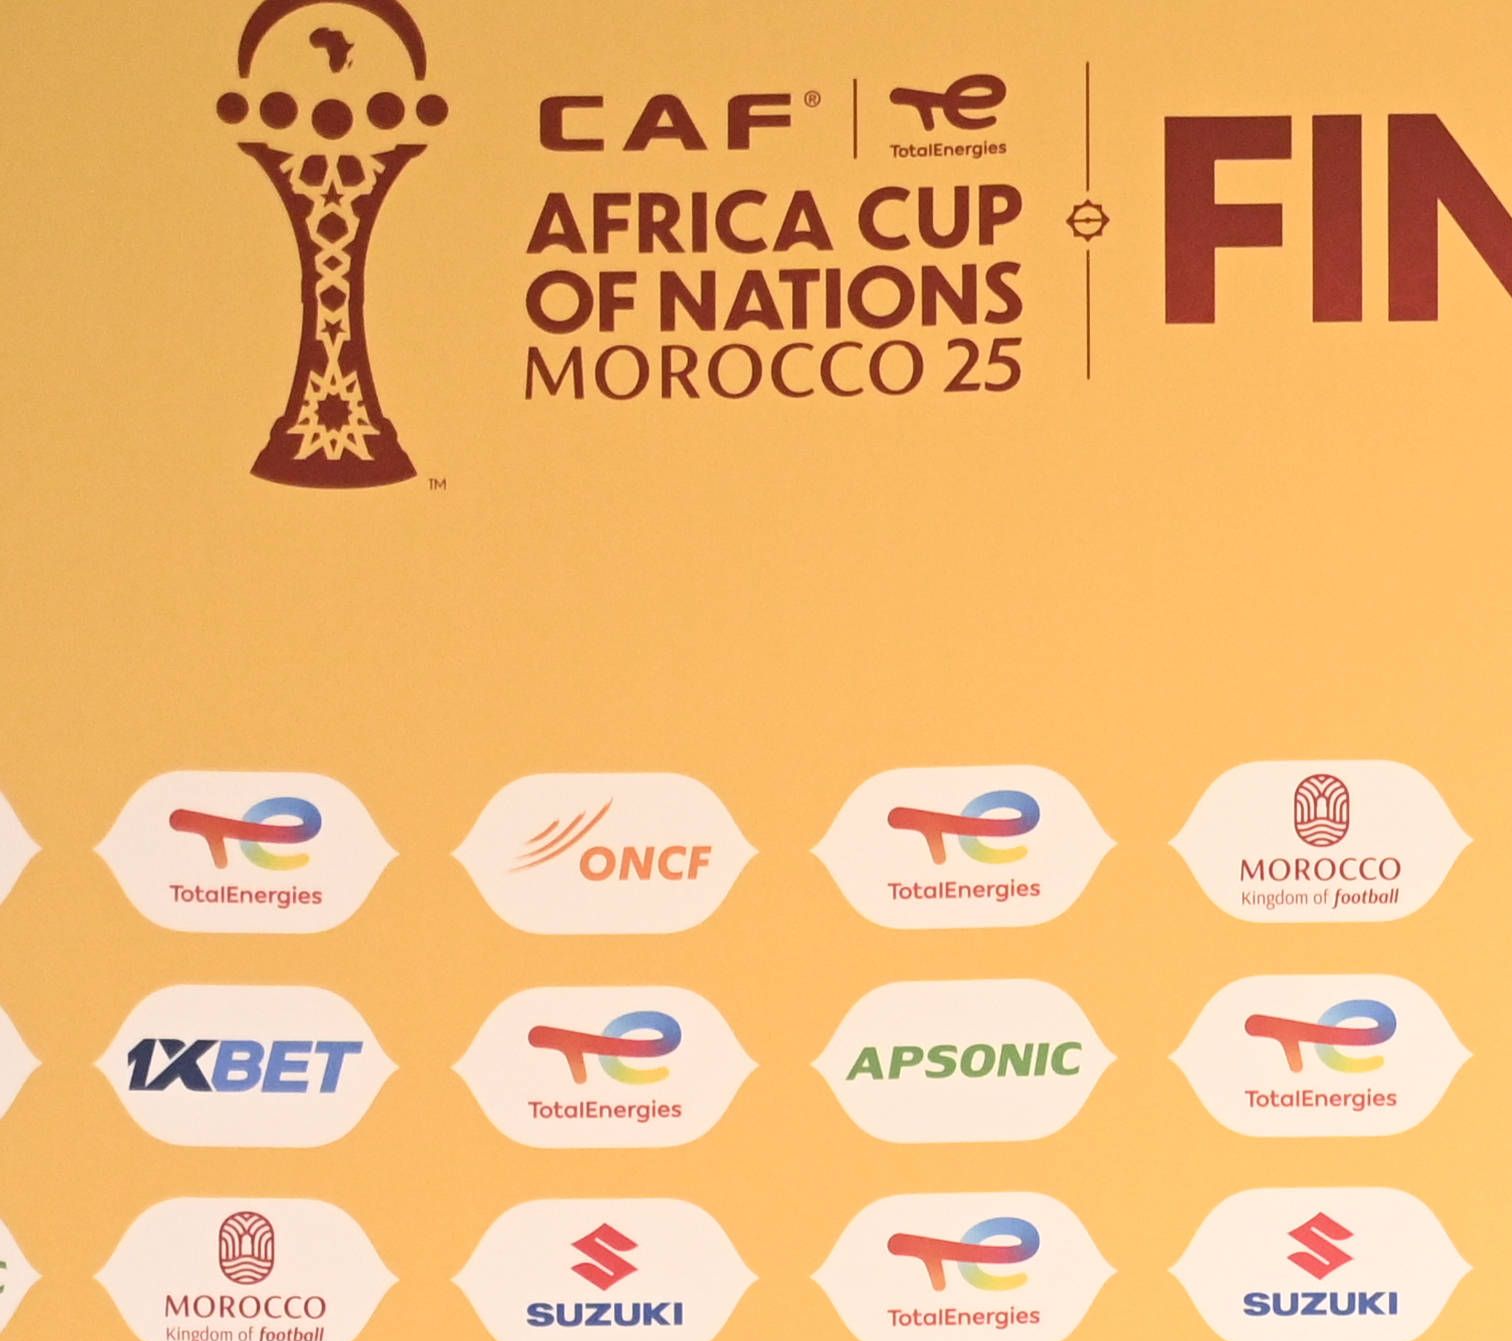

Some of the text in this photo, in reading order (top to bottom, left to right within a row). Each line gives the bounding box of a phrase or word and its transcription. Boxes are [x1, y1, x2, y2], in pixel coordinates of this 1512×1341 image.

[540, 93, 791, 151] CAF
[890, 141, 1006, 159] TotalEnergies
[527, 184, 1022, 254] AFRICA CUP
[526, 261, 1022, 334] OF NATIONS
[525, 337, 1022, 400] MOROCCO 25
[580, 845, 712, 881] ONCF
[1241, 858, 1400, 881] MOROCCO
[888, 879, 1040, 902] TotalEnergies
[1242, 888, 1399, 910] Kingdom of football
[128, 1039, 362, 1092] 1XBET
[846, 1042, 1082, 1080] APSONIC
[1245, 1088, 1396, 1111] TotalEnergies
[165, 1295, 326, 1319] MOROCCO
[527, 1302, 682, 1327] SUZUKI
[1244, 1292, 1397, 1316] SUZUKI
[238, 1326, 253, 1341] of
